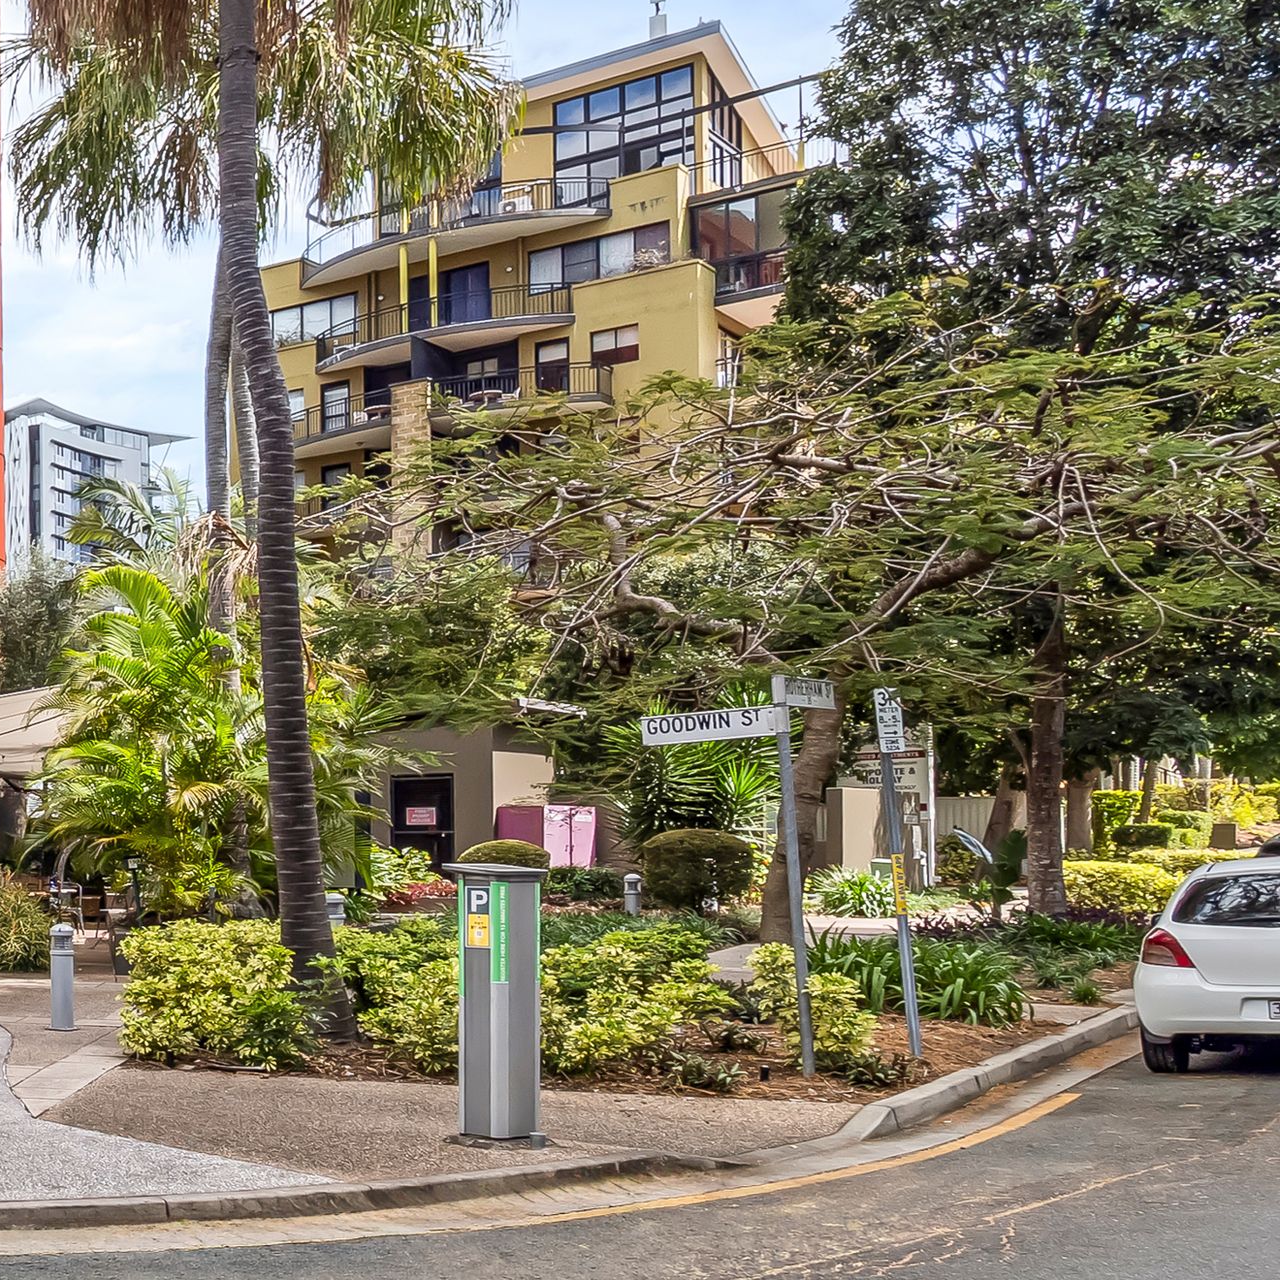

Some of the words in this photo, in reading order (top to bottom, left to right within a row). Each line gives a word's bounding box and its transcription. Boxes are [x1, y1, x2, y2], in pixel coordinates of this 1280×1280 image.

[647, 712, 730, 735] GOODWIN
[741, 709, 761, 727] ST
[470, 890, 488, 912] P
